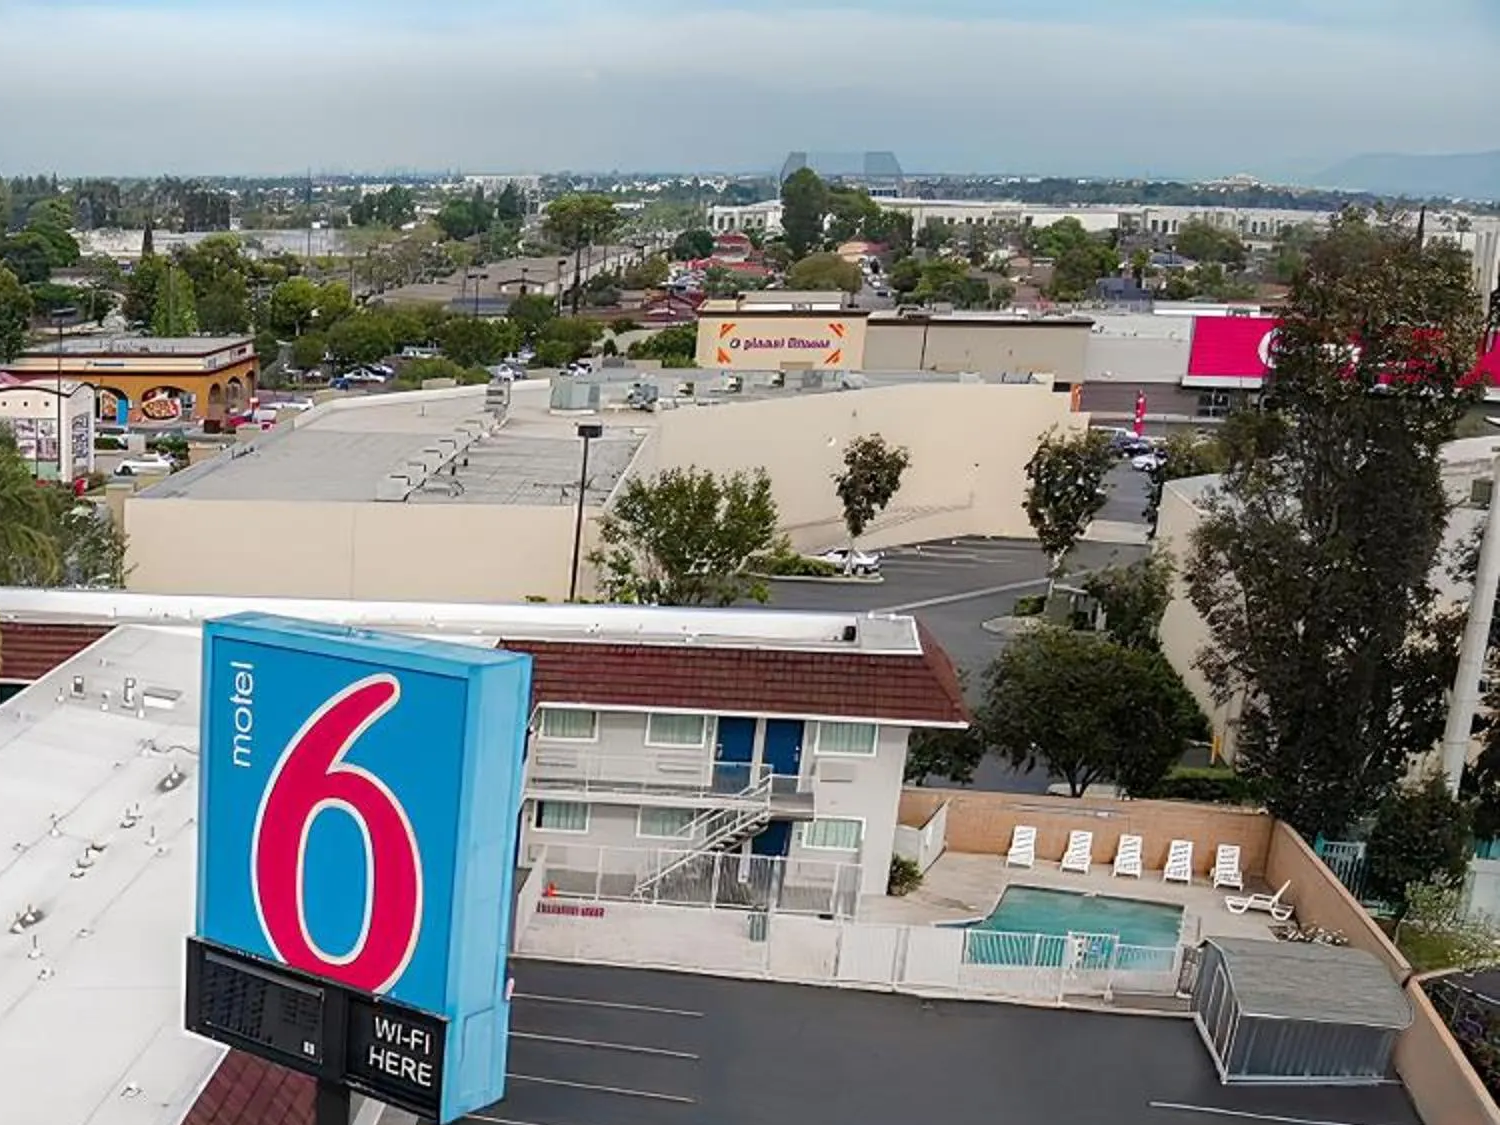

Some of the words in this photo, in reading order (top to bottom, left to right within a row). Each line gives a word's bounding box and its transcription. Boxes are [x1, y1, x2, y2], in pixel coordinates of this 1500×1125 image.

[231, 661, 254, 767] motel
[250, 673, 423, 995] 6
[368, 1046, 433, 1087] HERE
[375, 1016, 431, 1054] WI-FI
